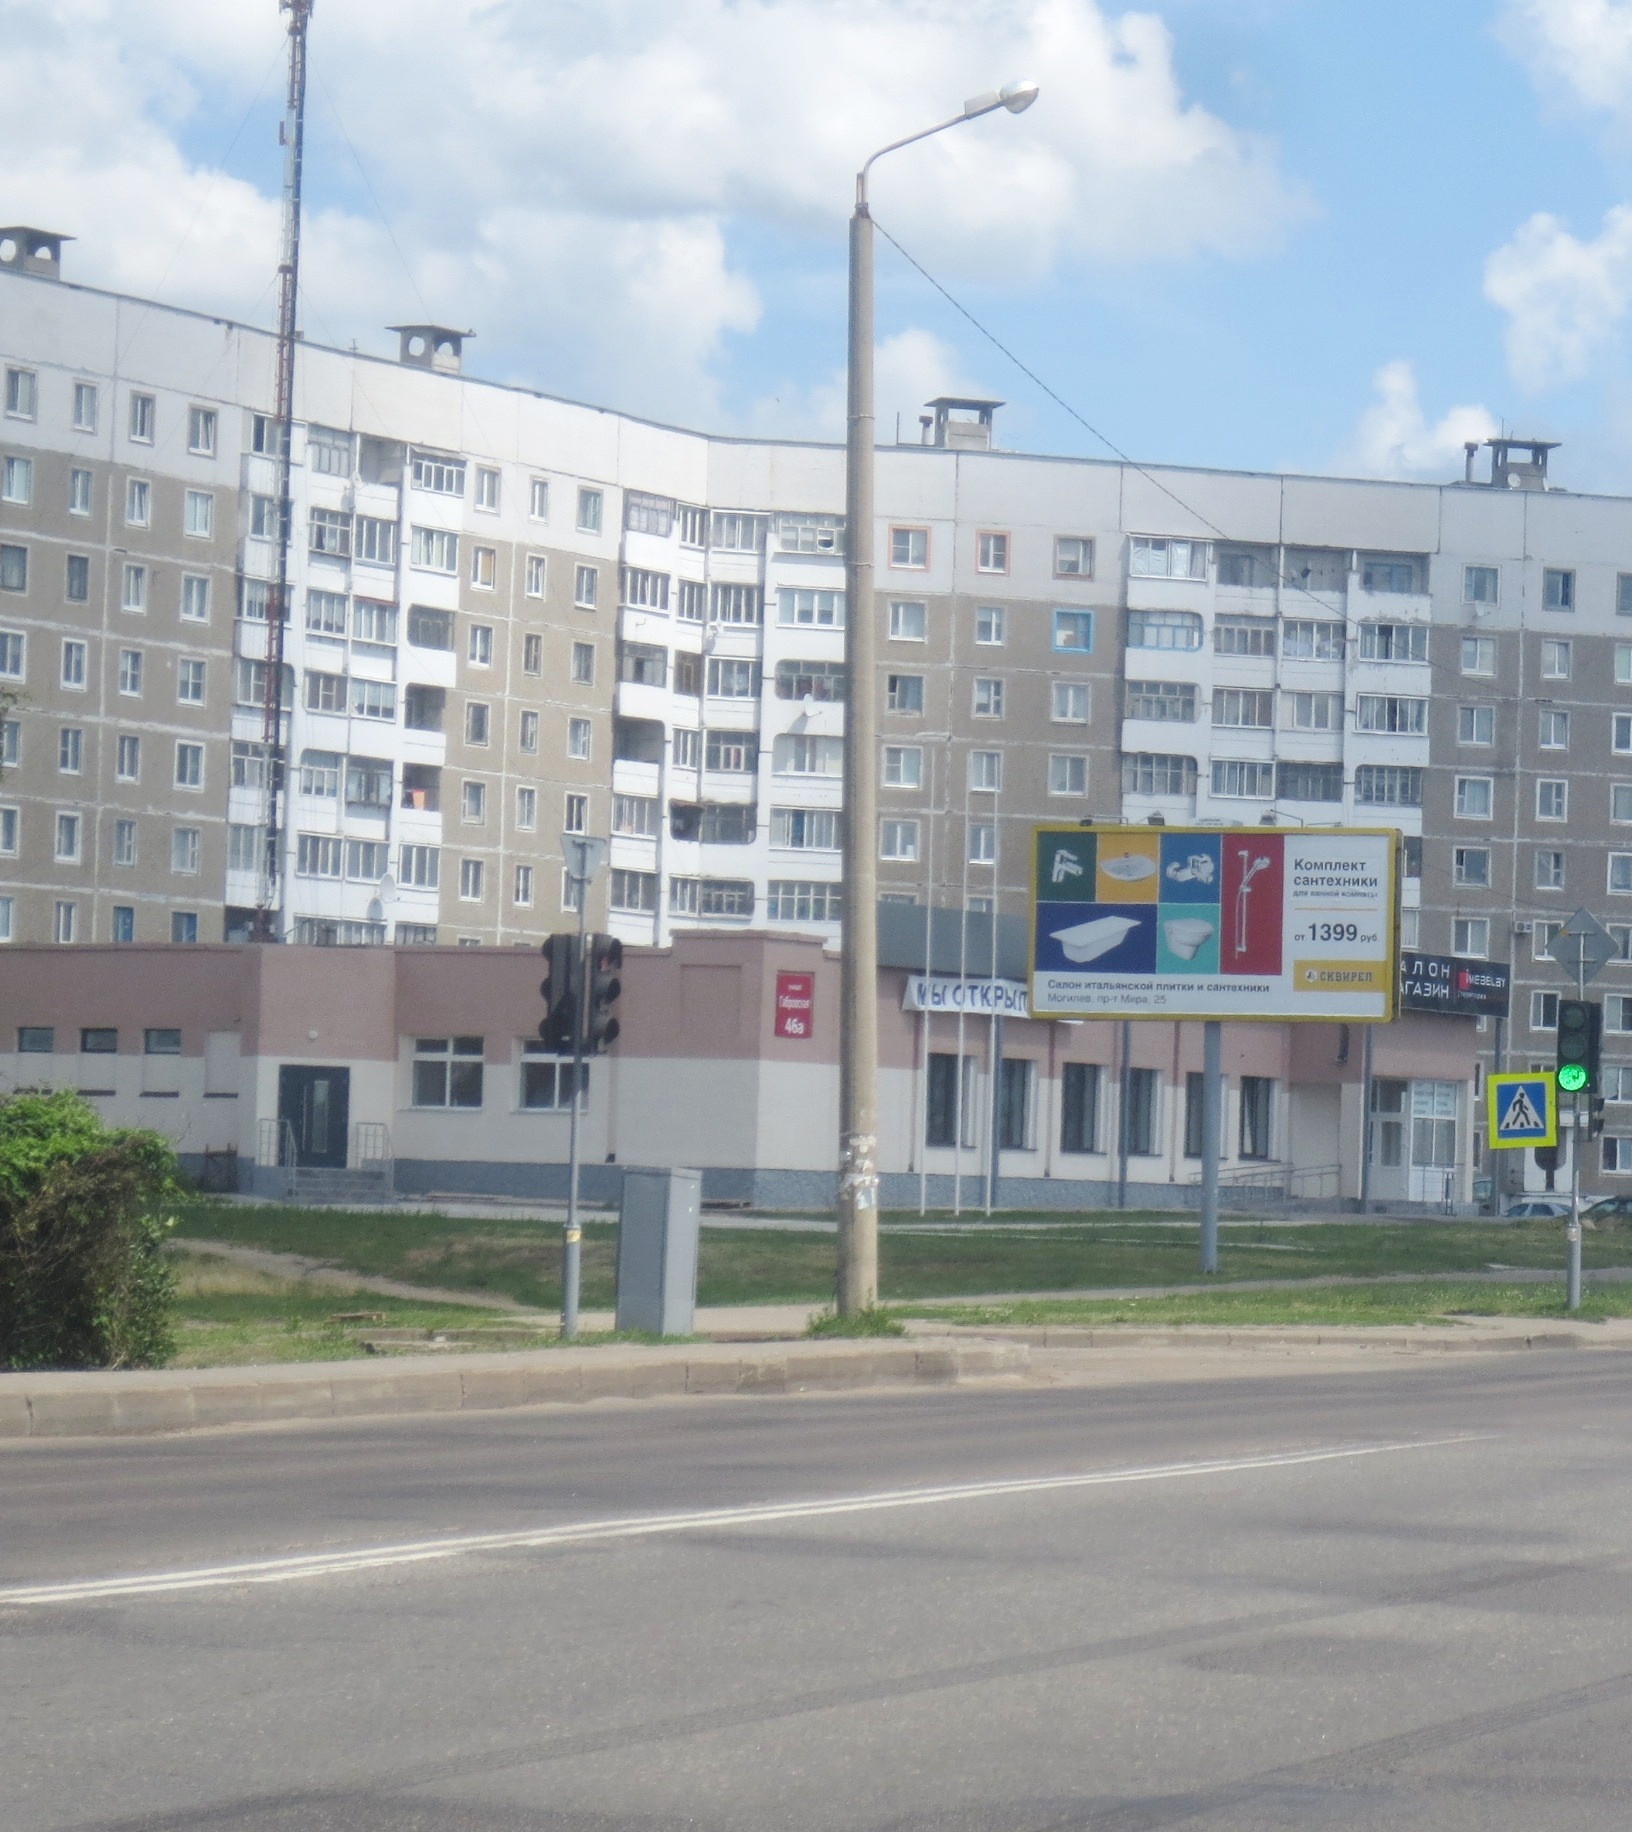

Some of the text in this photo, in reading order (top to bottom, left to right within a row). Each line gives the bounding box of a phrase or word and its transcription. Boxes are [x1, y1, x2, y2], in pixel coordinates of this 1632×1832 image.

[1294, 858, 1366, 872] Комплект
[1293, 875, 1378, 887] сантехники
[1294, 934, 1305, 942] от
[1307, 923, 1358, 942] 1399
[1047, 979, 1270, 993] Салон итальянской плитки и сантехники
[1097, 995, 1118, 1005] пр-т
[1153, 994, 1167, 1004] 25
[784, 1017, 805, 1034] 46а
